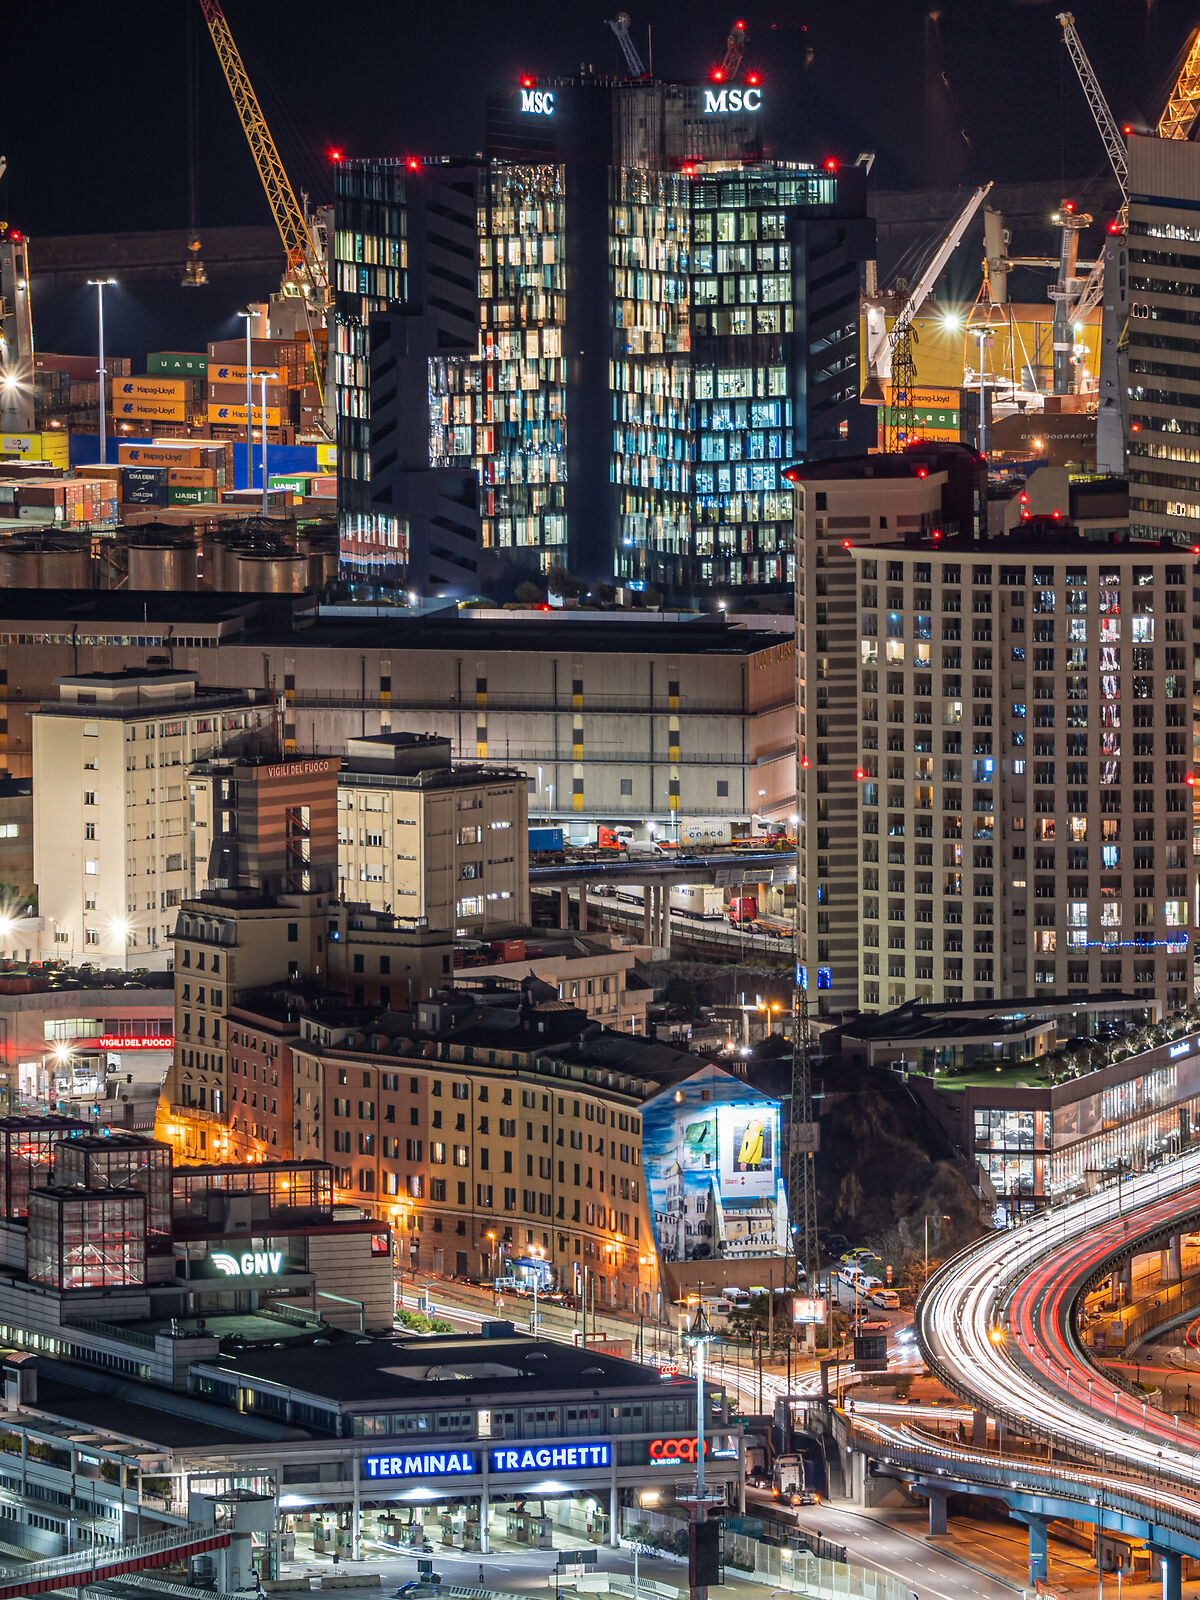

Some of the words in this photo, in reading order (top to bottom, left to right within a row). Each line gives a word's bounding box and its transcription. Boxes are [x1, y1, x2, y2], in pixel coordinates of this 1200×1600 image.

[521, 89, 554, 115] MSC
[704, 88, 762, 113] MSC
[161, 361, 205, 369] UASC
[137, 386, 175, 395] Hapag-Lloyd
[137, 406, 175, 414] Hapag-Lloyd
[143, 452, 182, 461] Hapag-Lloyd
[175, 492, 197, 500] UASC
[268, 766, 289, 777] VIGILI
[291, 764, 303, 775] DEL
[304, 761, 329, 773] FUOCO
[100, 1039, 124, 1047] VIGILI
[125, 1039, 141, 1047] DEL
[142, 1039, 171, 1047] FUOCO
[241, 1252, 282, 1275] GNV
[661, 1364, 679, 1375] coop
[650, 1437, 708, 1463] coop
[367, 1452, 473, 1476] TERMINAL
[494, 1446, 608, 1469] TRAGHETTI
